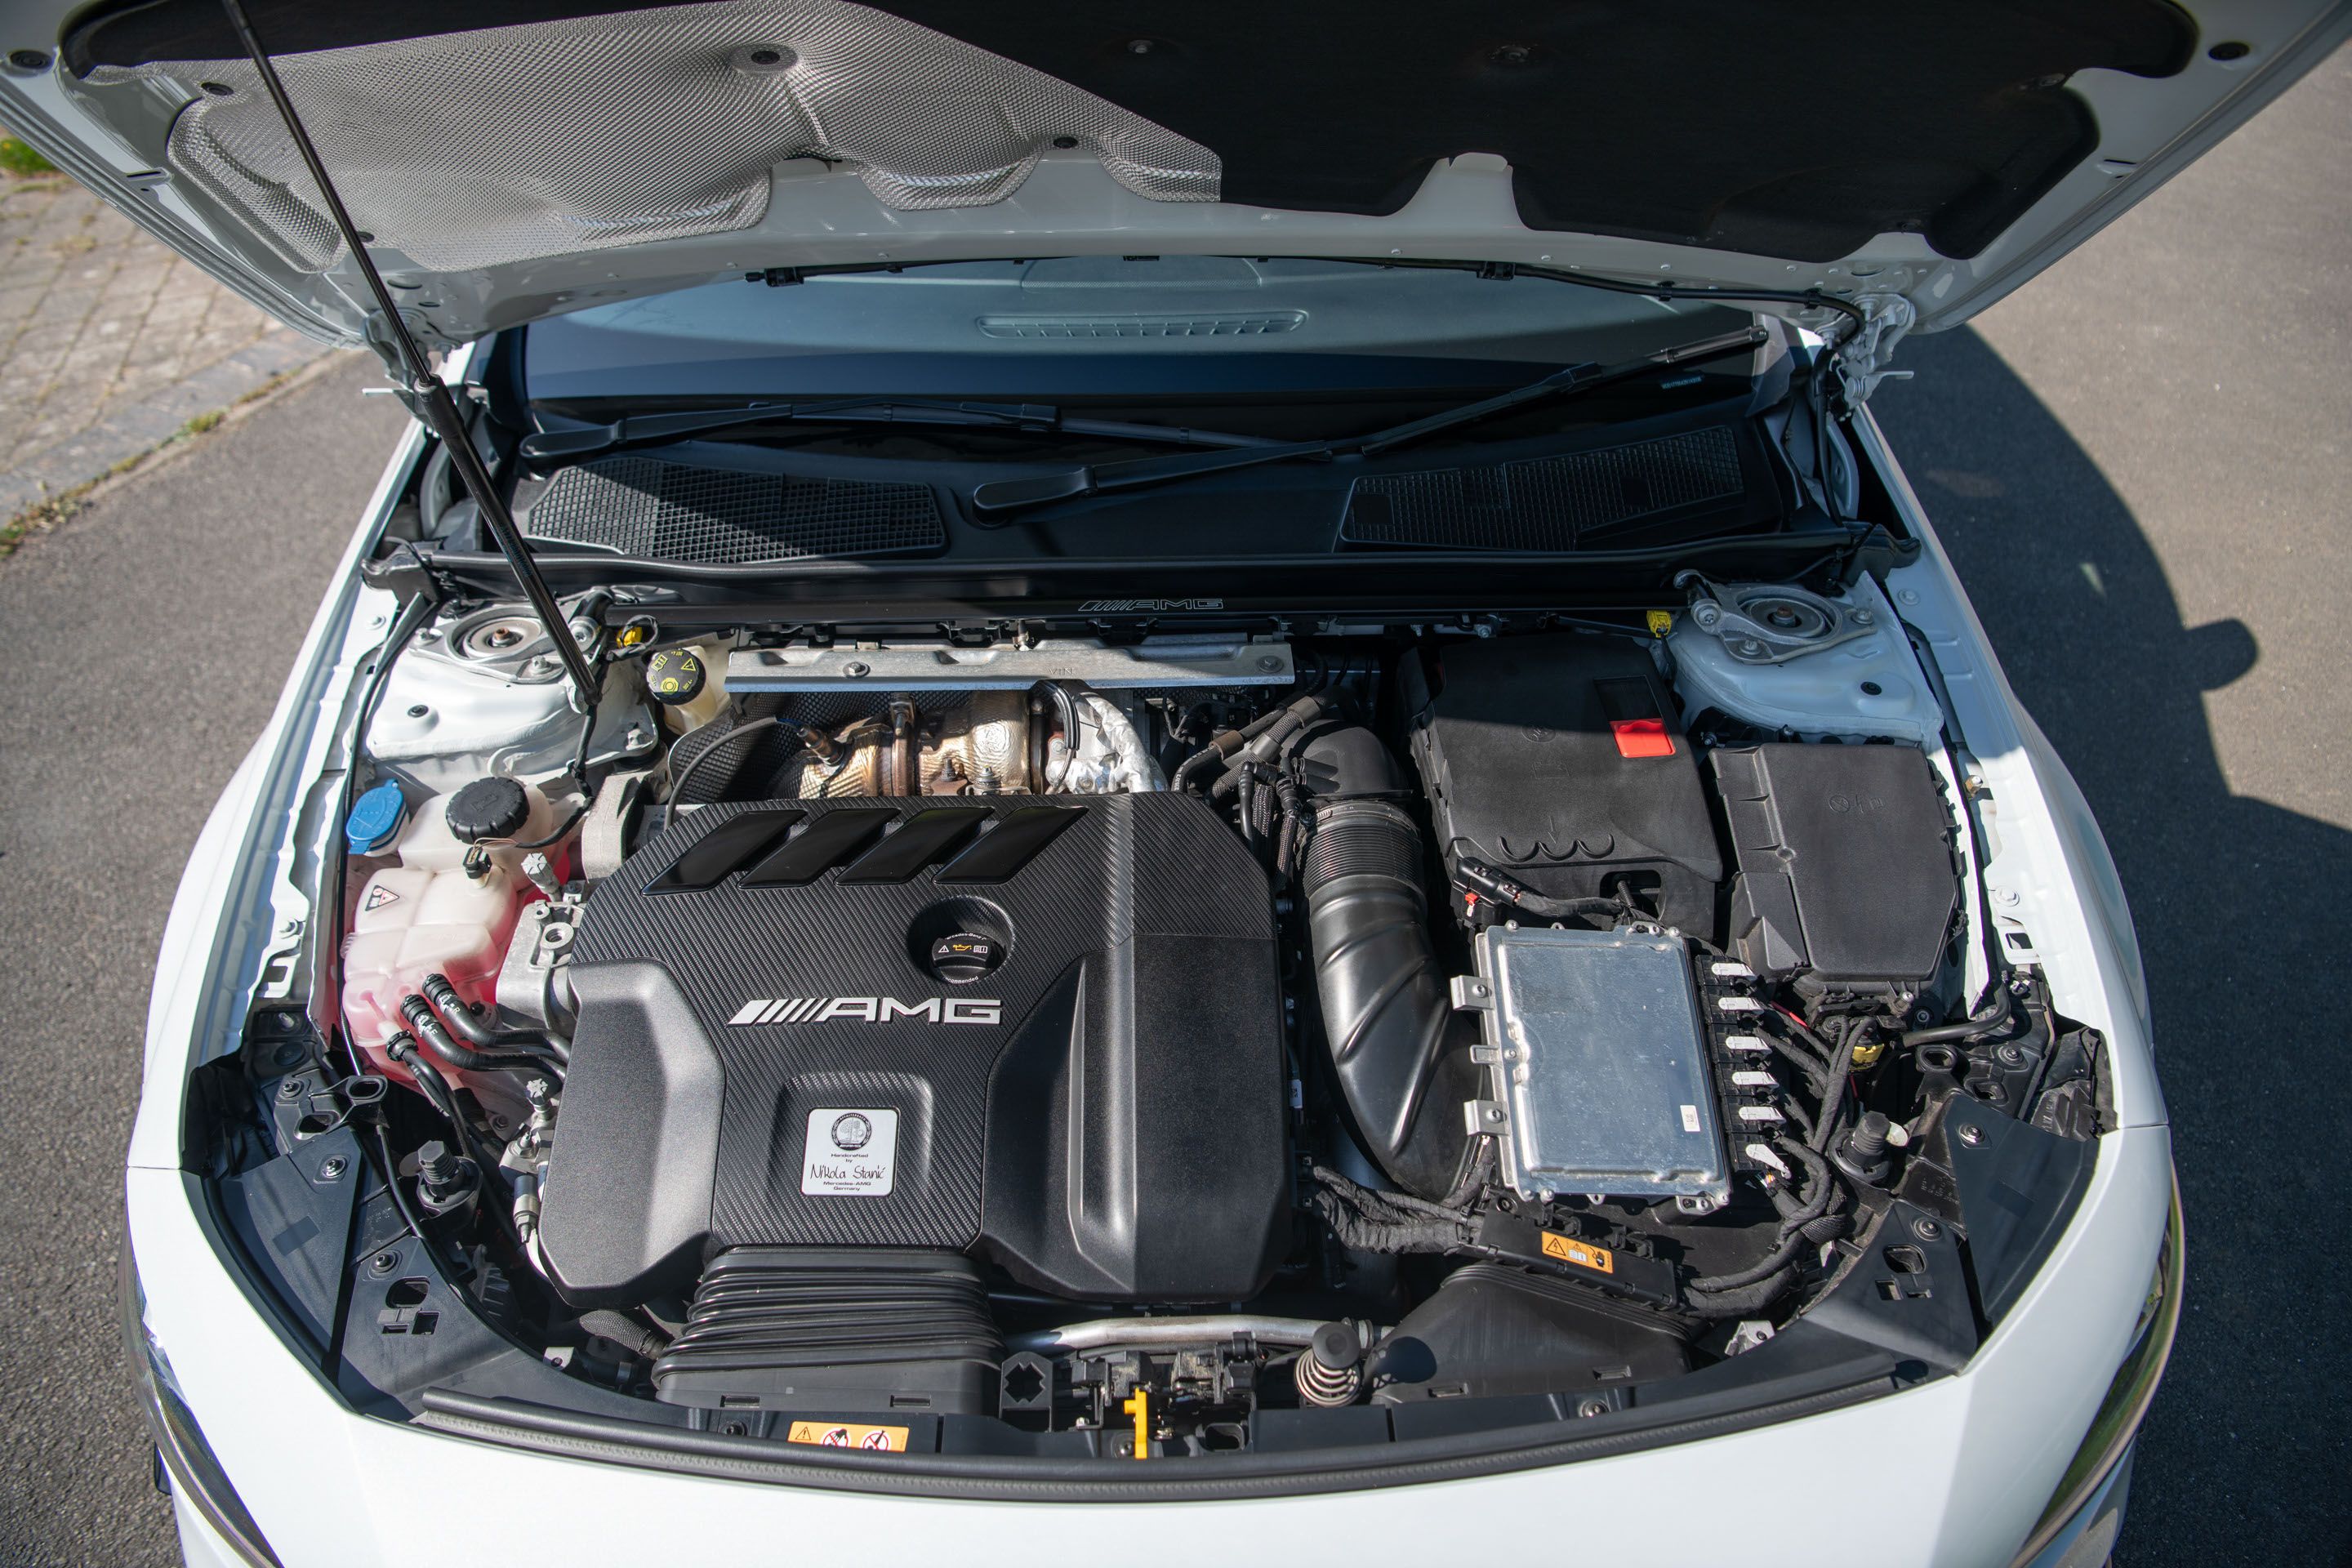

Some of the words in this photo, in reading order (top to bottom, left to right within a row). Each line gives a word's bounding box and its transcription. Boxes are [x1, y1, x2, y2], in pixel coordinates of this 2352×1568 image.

[1126, 598, 1224, 610] AMG
[1048, 666, 1074, 675] VIN
[813, 997, 1001, 1025] AMG
[810, 1164, 846, 1179] Nikola
[853, 1165, 886, 1179] Stanić
